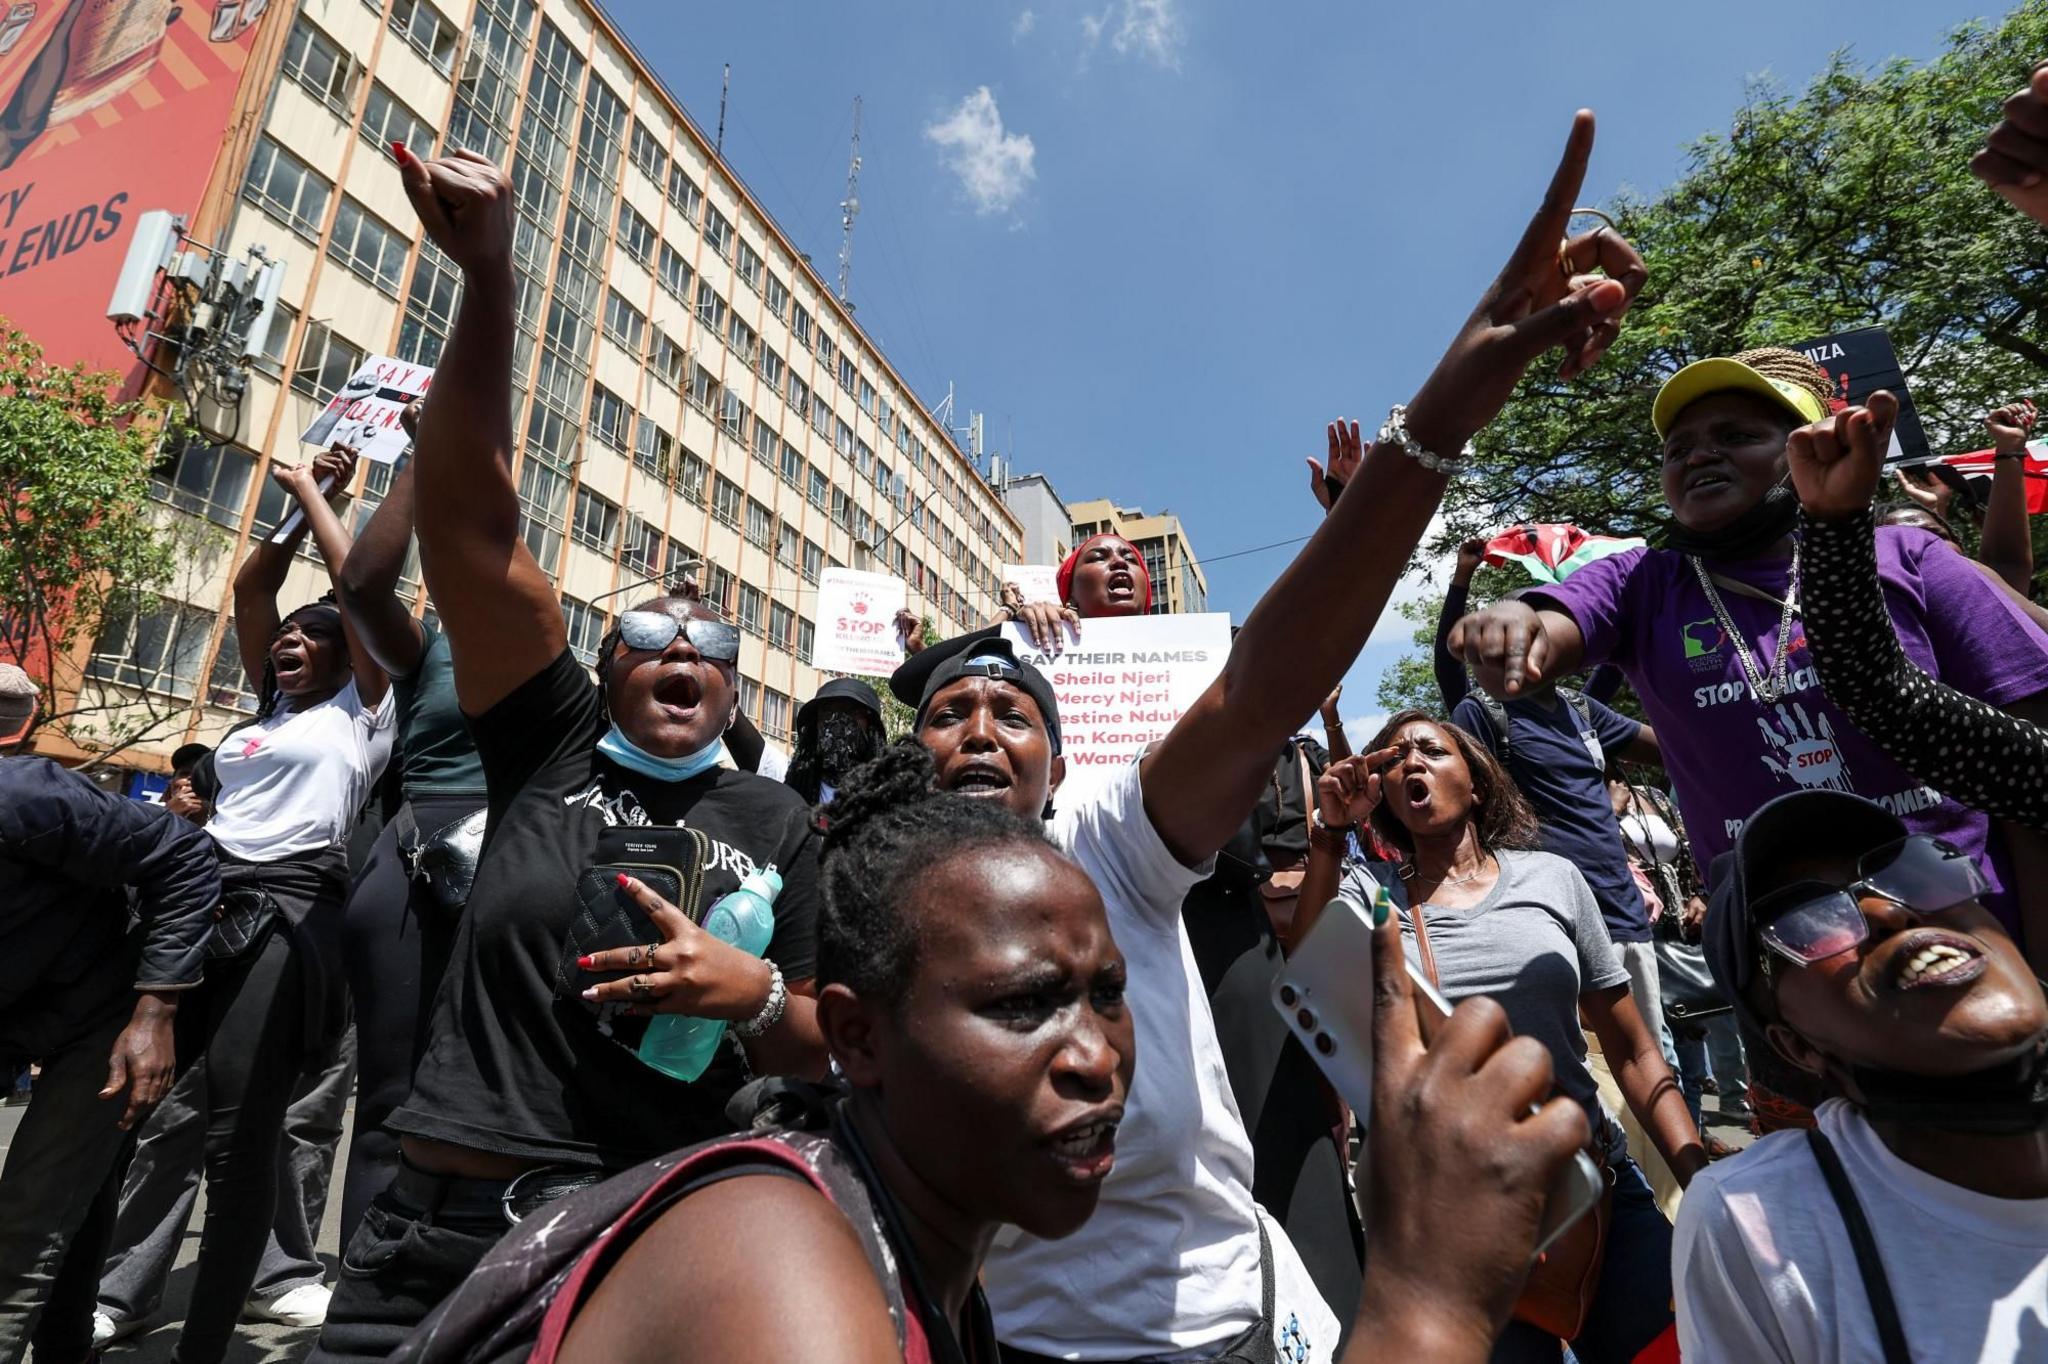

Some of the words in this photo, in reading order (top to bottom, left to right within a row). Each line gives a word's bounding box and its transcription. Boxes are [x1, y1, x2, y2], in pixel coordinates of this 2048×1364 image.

[0, 182, 35, 228] Y
[376, 363, 415, 386] SAY
[836, 617, 886, 634] STOP
[1020, 653, 1060, 666] SAY
[1065, 652, 1125, 664] THEIR
[1132, 650, 1208, 663] NAMES
[1053, 672, 1115, 686] Sheila
[1122, 670, 1170, 687] Njeri
[1055, 692, 1115, 707] Mercy
[1119, 689, 1169, 705] Njeri
[1694, 681, 1744, 707] STOP
[1061, 711, 1123, 724] estine
[1129, 710, 1184, 723] Nduk
[1061, 735, 1085, 745] nn
[1092, 730, 1166, 744] Kanair
[1797, 750, 1833, 768] STOP
[1725, 819, 1750, 839] PR
[1871, 786, 1942, 817] OMEN
